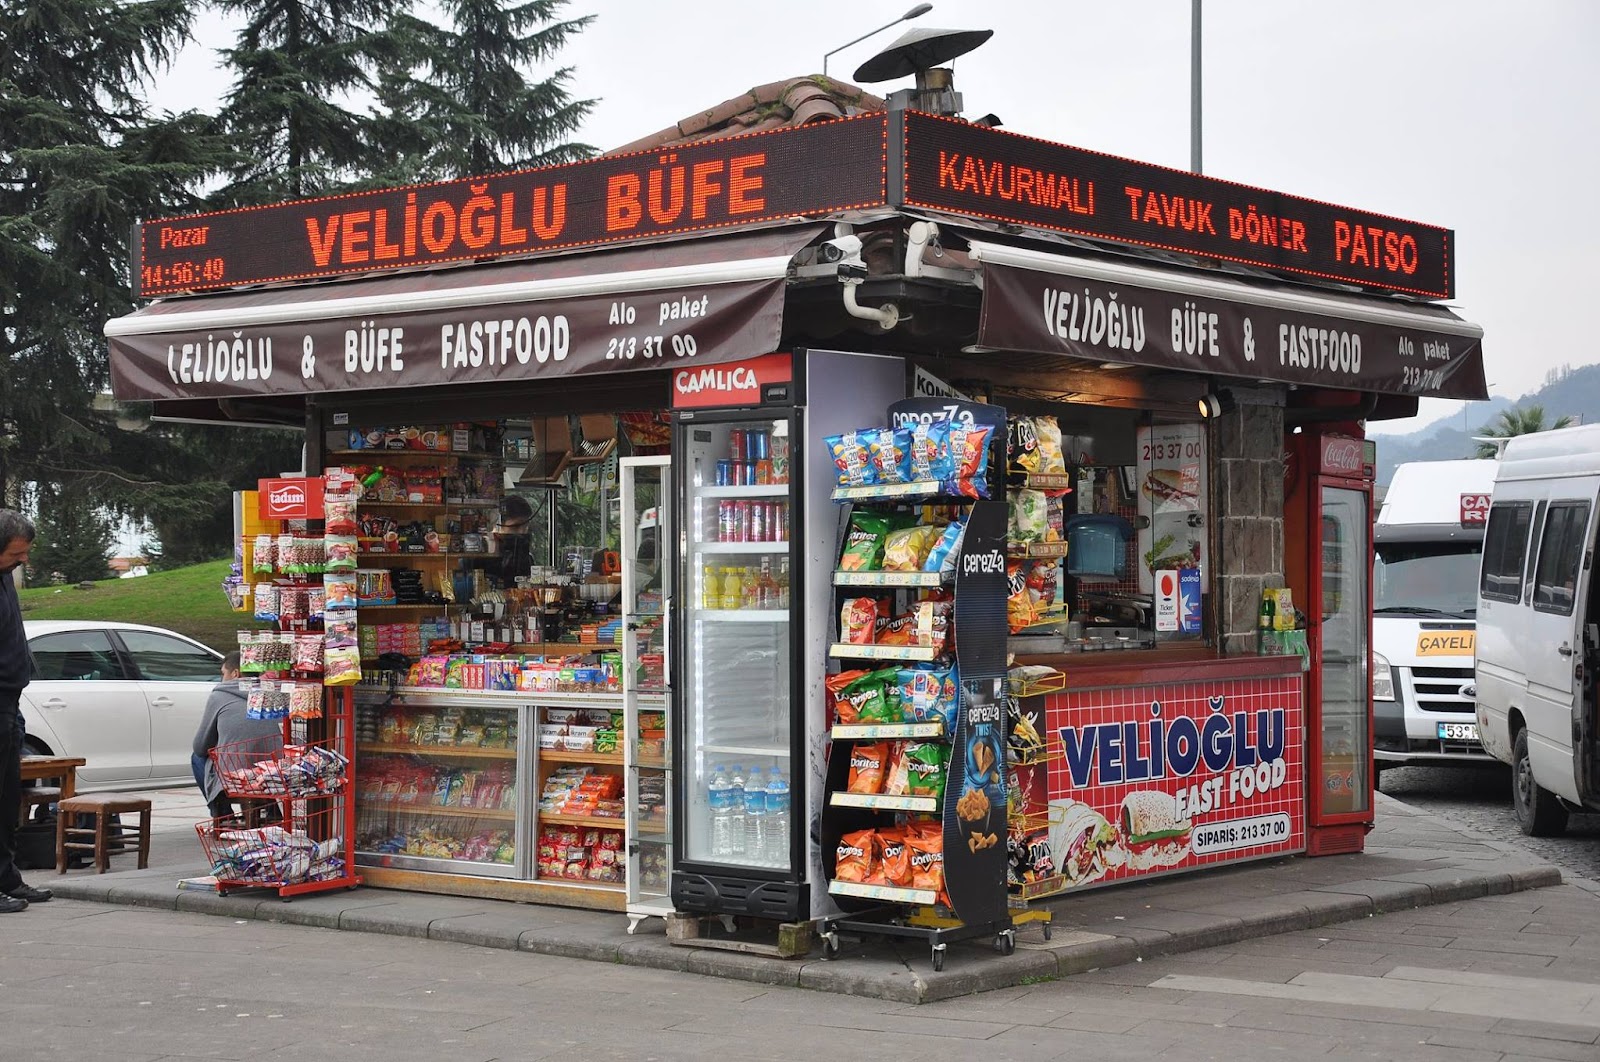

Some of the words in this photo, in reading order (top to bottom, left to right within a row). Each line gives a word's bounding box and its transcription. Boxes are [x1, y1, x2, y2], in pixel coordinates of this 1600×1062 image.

[305, 182, 568, 268] VELİOĞLU
[606, 153, 766, 232] BÜFE
[939, 150, 1095, 216] KAVURMALI
[1124, 186, 1216, 236] TAVUK
[1228, 204, 1308, 253] DÖNER
[1333, 219, 1418, 275] PATSO
[160, 227, 210, 250] Pazar
[145, 258, 225, 288] 14:56:49
[609, 302, 636, 326] Alo
[659, 294, 708, 326] paket
[1043, 287, 1146, 352] VELİOĞLU
[1171, 302, 1220, 357] BÜFE
[1243, 317, 1256, 362] &
[1279, 323, 1362, 374] FASTFOOD
[301, 334, 316, 380] &
[344, 321, 404, 374] BÜFE
[441, 314, 570, 370] FASTFOOD
[605, 337, 636, 361] 213
[642, 335, 664, 360] 37
[672, 334, 697, 357] 00
[1398, 335, 1414, 356] Alo
[1423, 340, 1450, 361] paket
[675, 367, 758, 395] ÇAMLICA
[1403, 365, 1420, 386] 213
[1143, 443, 1164, 460] 213
[1167, 443, 1183, 459] 37
[1185, 442, 1201, 458] 00
[1419, 634, 1473, 652] ÇAYELİ
[975, 723, 993, 737] TWIST
[1059, 695, 1286, 789] VELİOĞLU
[1447, 725, 1464, 738] 53
[850, 758, 880, 769] Doritos
[907, 762, 940, 773] Doritos
[1174, 775, 1225, 823] FAST
[1229, 756, 1287, 804] FOOD
[1197, 824, 1239, 847] SİPARİŞ:
[1240, 825, 1258, 841] 213
[1260, 823, 1272, 837] 37
[1273, 821, 1285, 835] 00
[911, 853, 943, 866] Doritos
